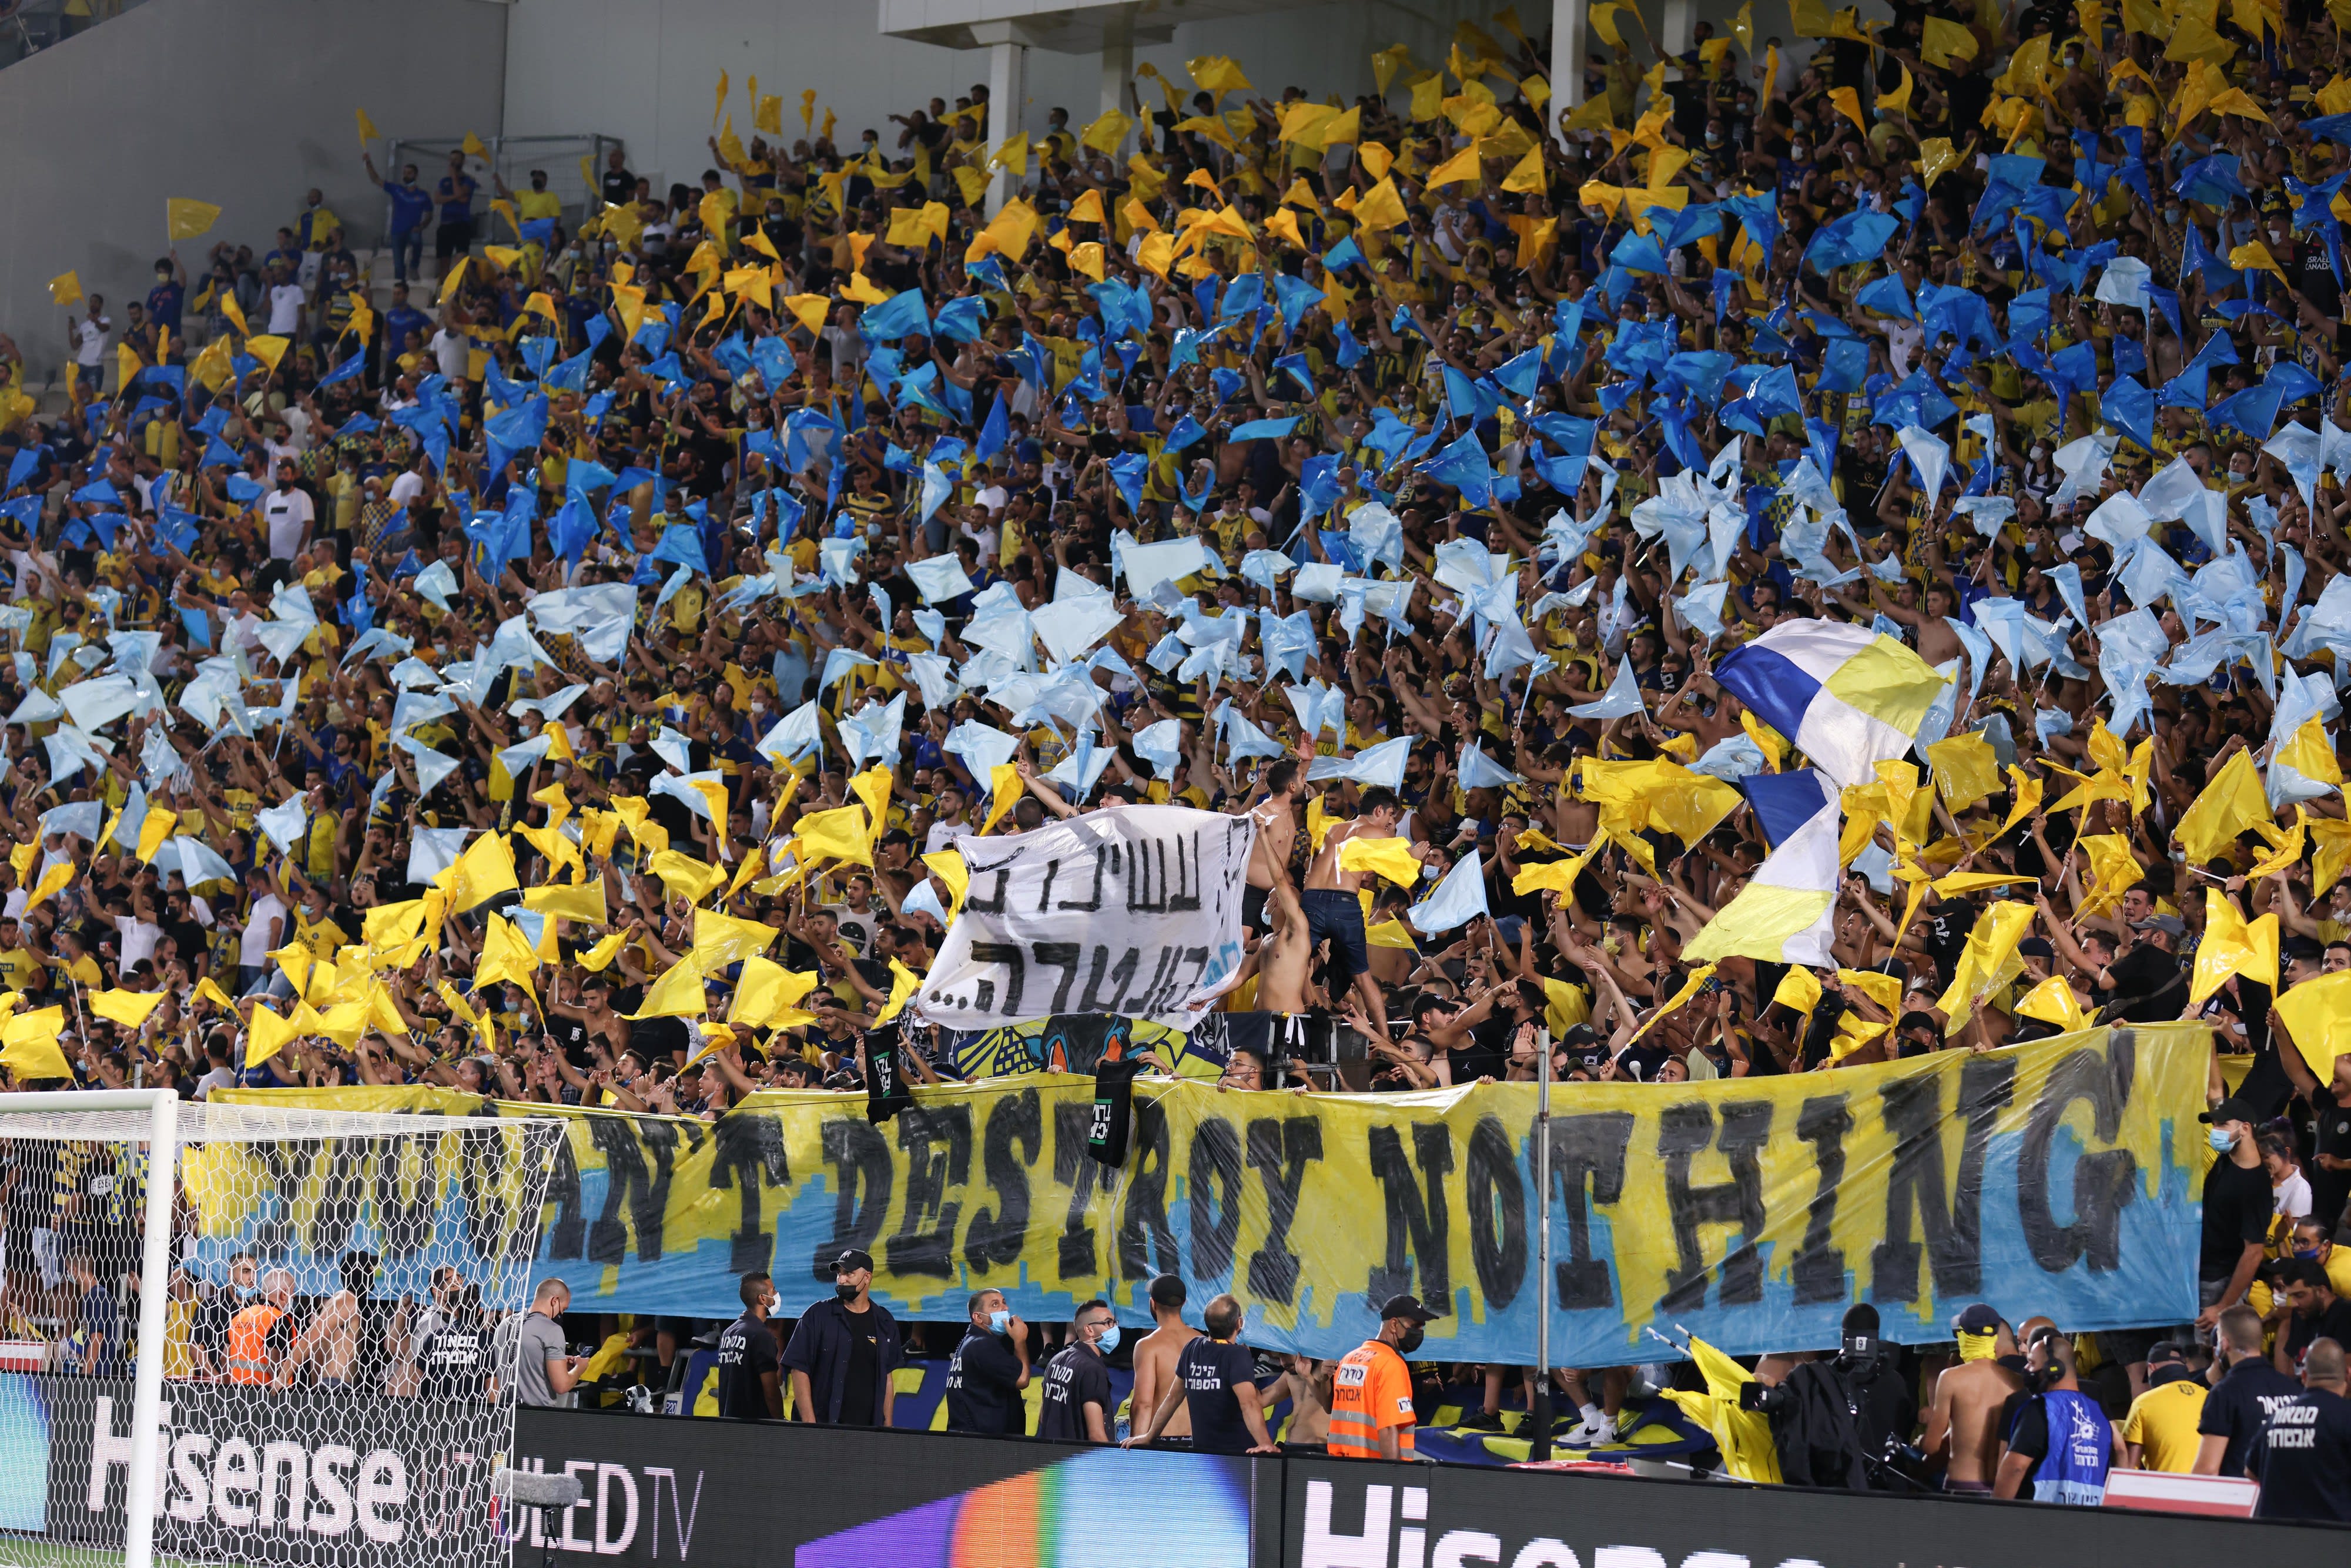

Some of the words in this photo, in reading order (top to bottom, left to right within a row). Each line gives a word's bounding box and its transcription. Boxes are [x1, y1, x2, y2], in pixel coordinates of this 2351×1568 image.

[1093, 1104, 1111, 1121] TLV
[813, 1086, 1324, 1306] DESTROY
[1368, 1028, 2137, 1316] NOTHING
[665, 1402, 677, 1414] P20
[88, 1396, 408, 1542] Hisense
[644, 1467, 704, 1561] TV
